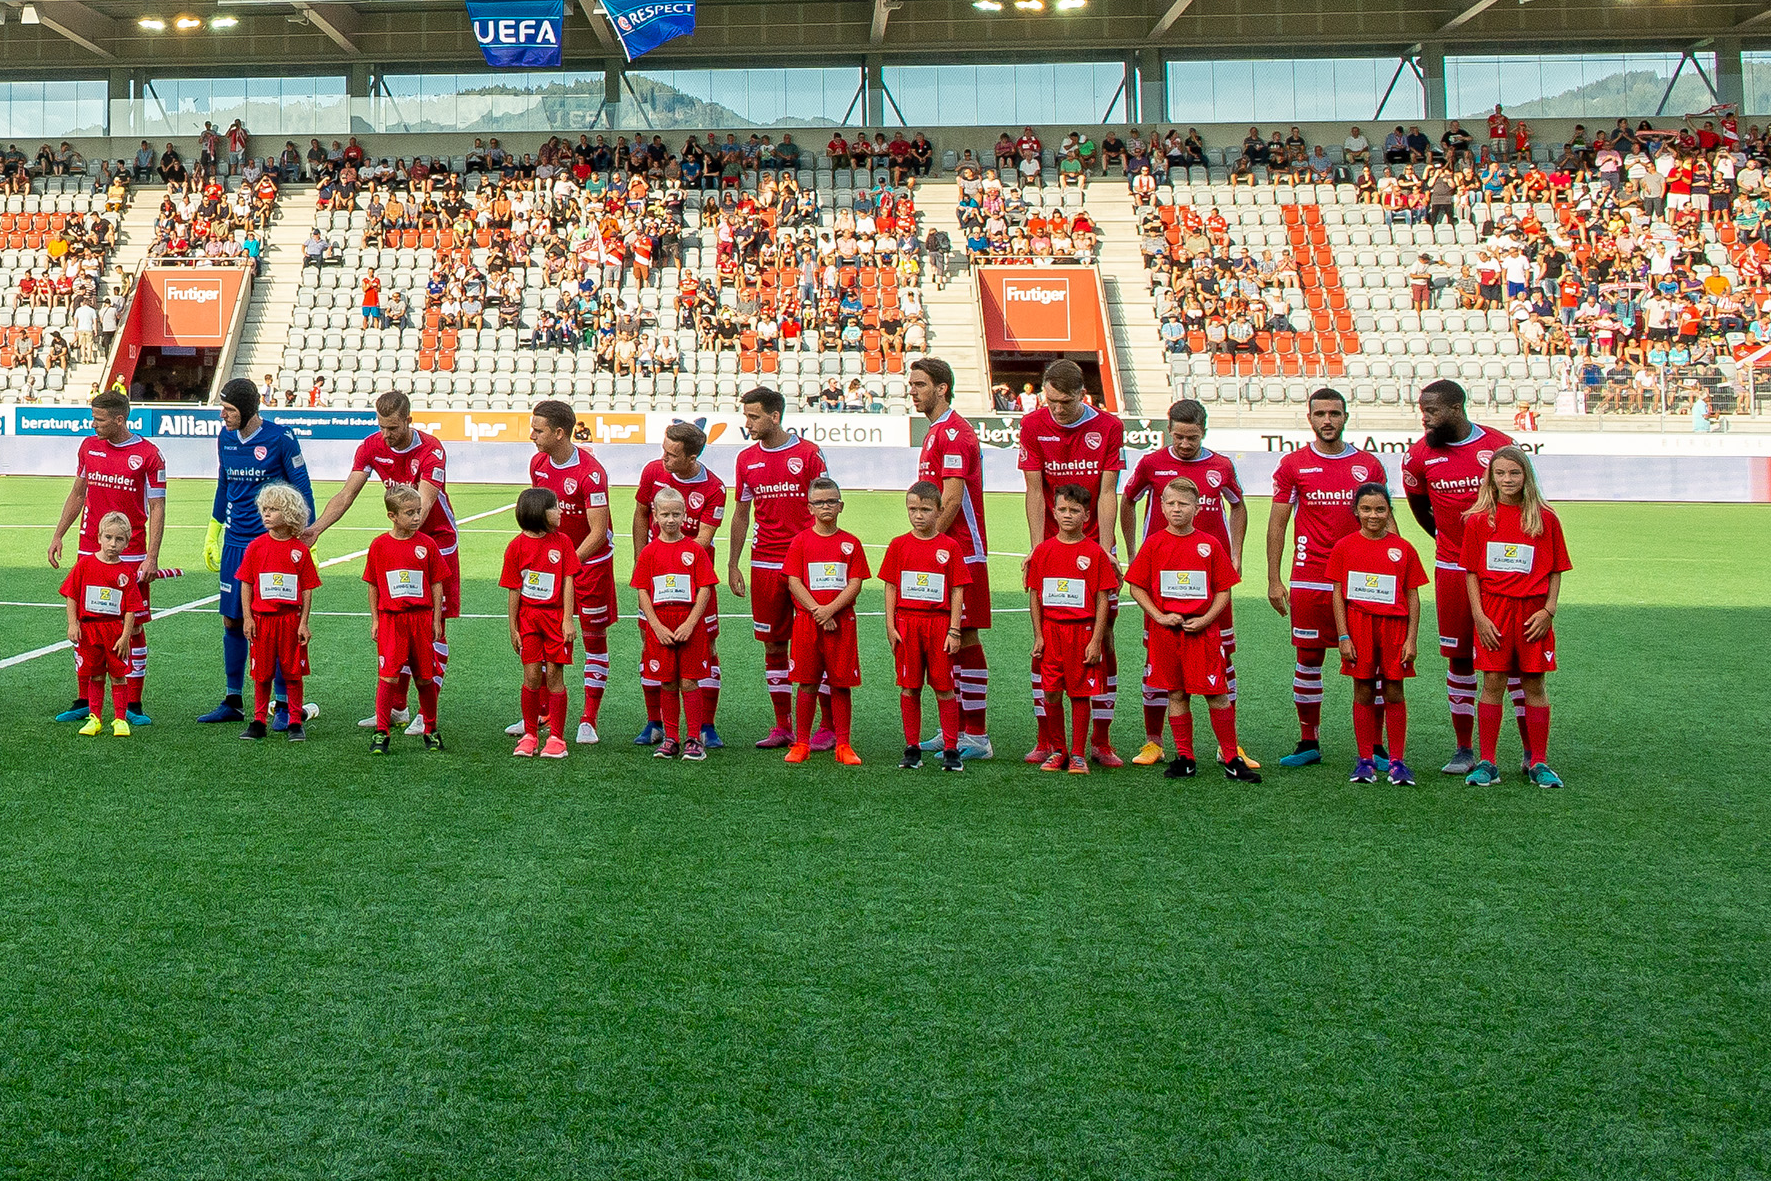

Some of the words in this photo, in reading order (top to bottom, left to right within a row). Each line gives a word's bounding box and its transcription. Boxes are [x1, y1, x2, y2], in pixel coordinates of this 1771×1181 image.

[628, 3, 694, 27] RESPECT
[474, 20, 556, 44] UEFA
[168, 286, 219, 303] Frutiger
[1007, 286, 1066, 304] Frutiger
[21, 416, 142, 433] beratung.trnd
[158, 415, 224, 436] Allian
[814, 423, 882, 442] beton
[88, 472, 135, 486] schneider
[1431, 477, 1484, 490] schneide
[1306, 489, 1354, 500] schneid
[1504, 545, 1518, 557] Z
[824, 564, 836, 576] Z
[273, 574, 283, 585] Z
[399, 571, 410, 583] Z
[529, 573, 539, 585] Z
[665, 575, 676, 587] Z
[917, 573, 929, 586] Z
[1177, 572, 1190, 584] Z
[1365, 575, 1378, 587] Z
[1057, 580, 1068, 592] Z
[100, 588, 110, 600] Z
